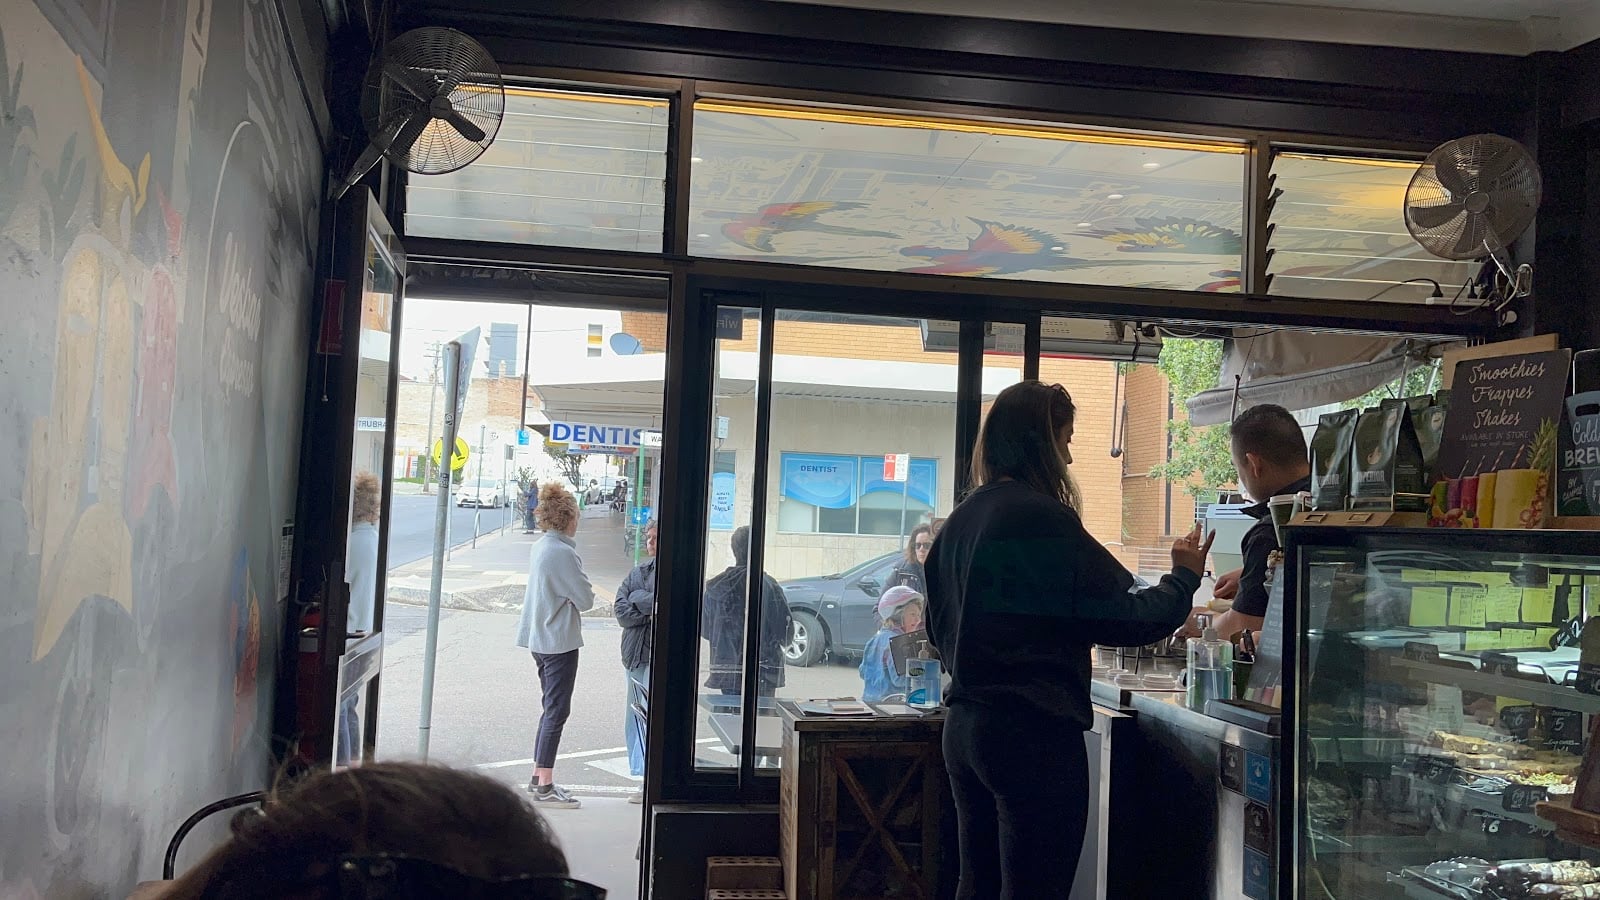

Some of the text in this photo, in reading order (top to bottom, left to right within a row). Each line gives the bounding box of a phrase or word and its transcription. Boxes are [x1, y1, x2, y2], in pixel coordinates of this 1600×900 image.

[1468, 359, 1546, 384] Smoothies
[1472, 385, 1535, 407] Frappes
[1473, 408, 1522, 429] Shakes
[552, 423, 662, 446] DENTIS
[1506, 430, 1529, 440] STORE
[800, 465, 838, 473] DENTIST
